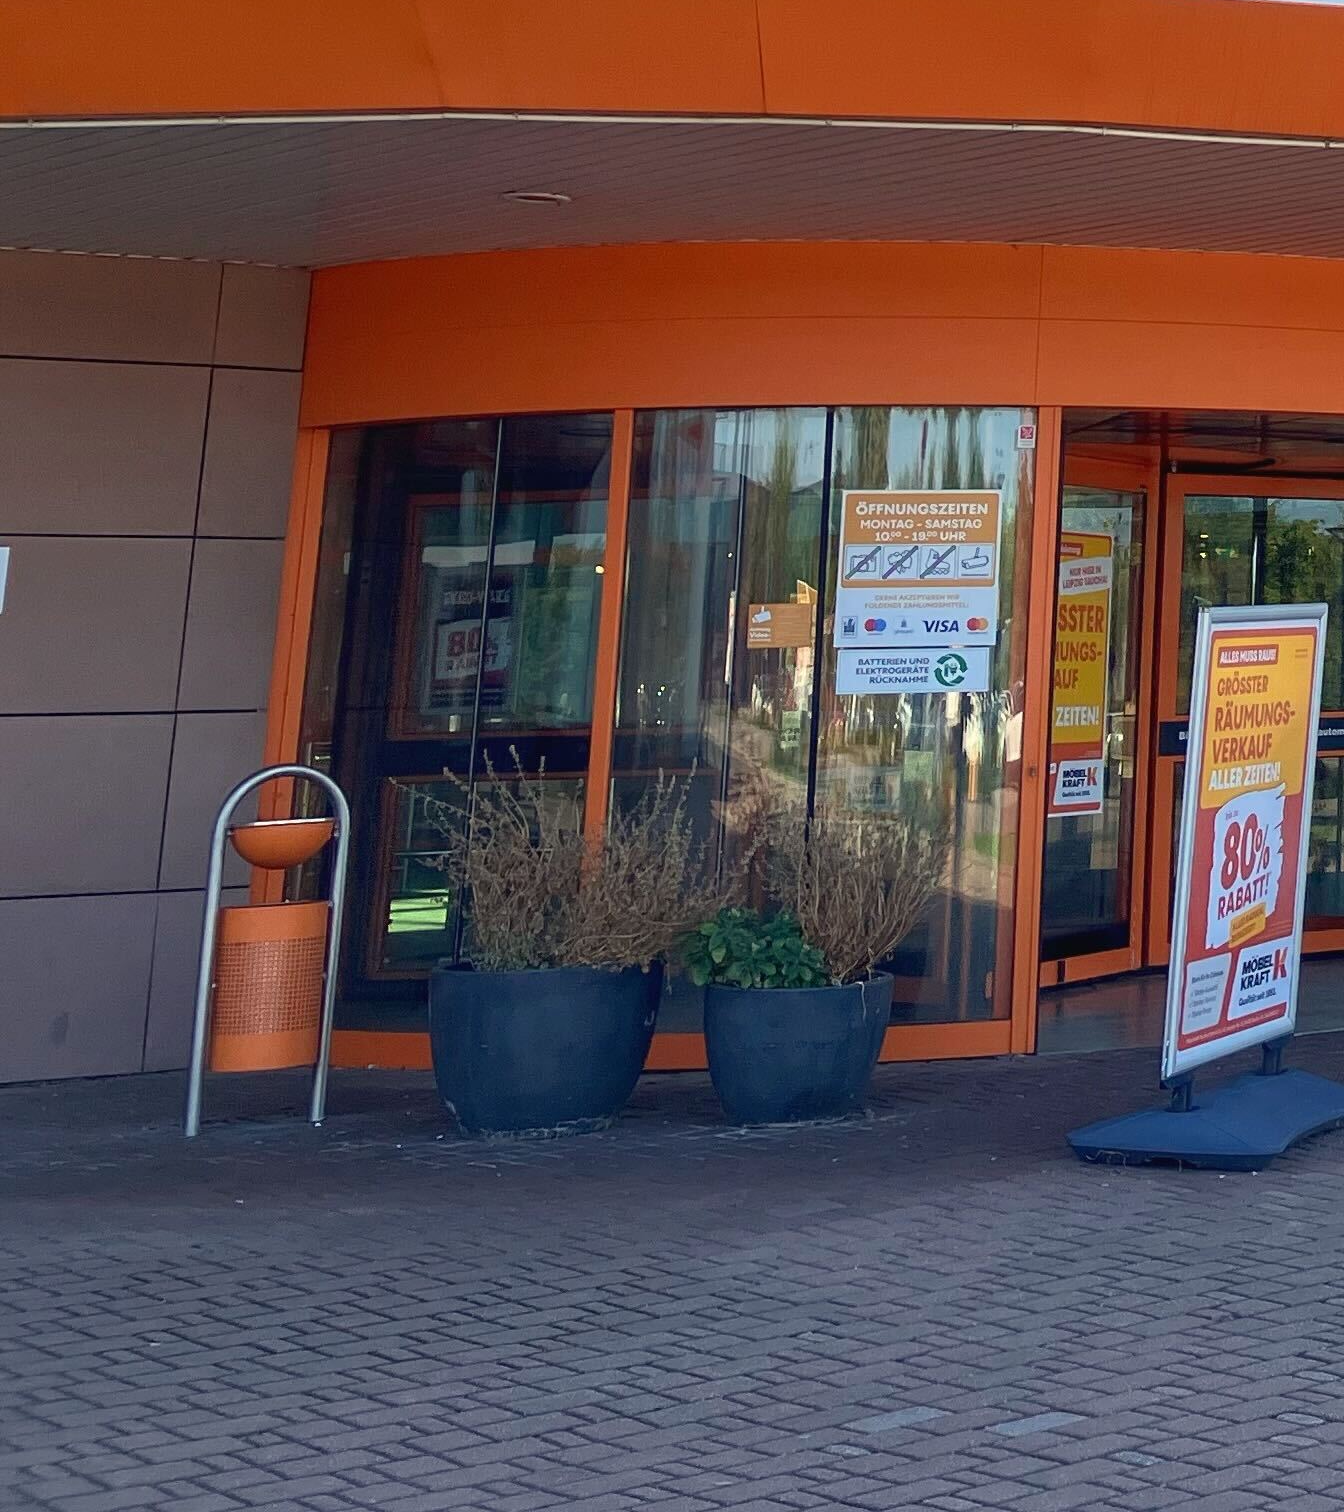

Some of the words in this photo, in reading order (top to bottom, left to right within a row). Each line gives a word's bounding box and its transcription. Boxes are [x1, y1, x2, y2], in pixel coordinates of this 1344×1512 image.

[855, 501, 988, 516] ÖFFNUNGSZEITEN
[860, 519, 914, 529] MONTAG
[925, 519, 983, 529] SAMSTAG
[940, 531, 967, 541] UHR
[922, 619, 960, 633] VISA
[1058, 604, 1105, 633] SSTER
[858, 658, 907, 666] BATTERIEN
[909, 657, 930, 665] UND
[1056, 641, 1102, 662] UNGS-
[855, 666, 929, 675] ELEKTROGERÄTE
[869, 675, 929, 684] RÜCKNAHME
[1217, 672, 1269, 696] GRÖSSTER
[1055, 706, 1100, 727] ZEITEN!
[1214, 700, 1295, 732] RÄUMUNGS-
[1212, 733, 1272, 764] VERKAUF
[1208, 766, 1243, 790] ALLER
[1243, 761, 1281, 787] ZEITEN!
[1221, 813, 1270, 890] 80%
[1218, 872, 1271, 920] RABATT!
[1242, 955, 1273, 976] MÖBEL
[1240, 969, 1271, 991] KRAFT
